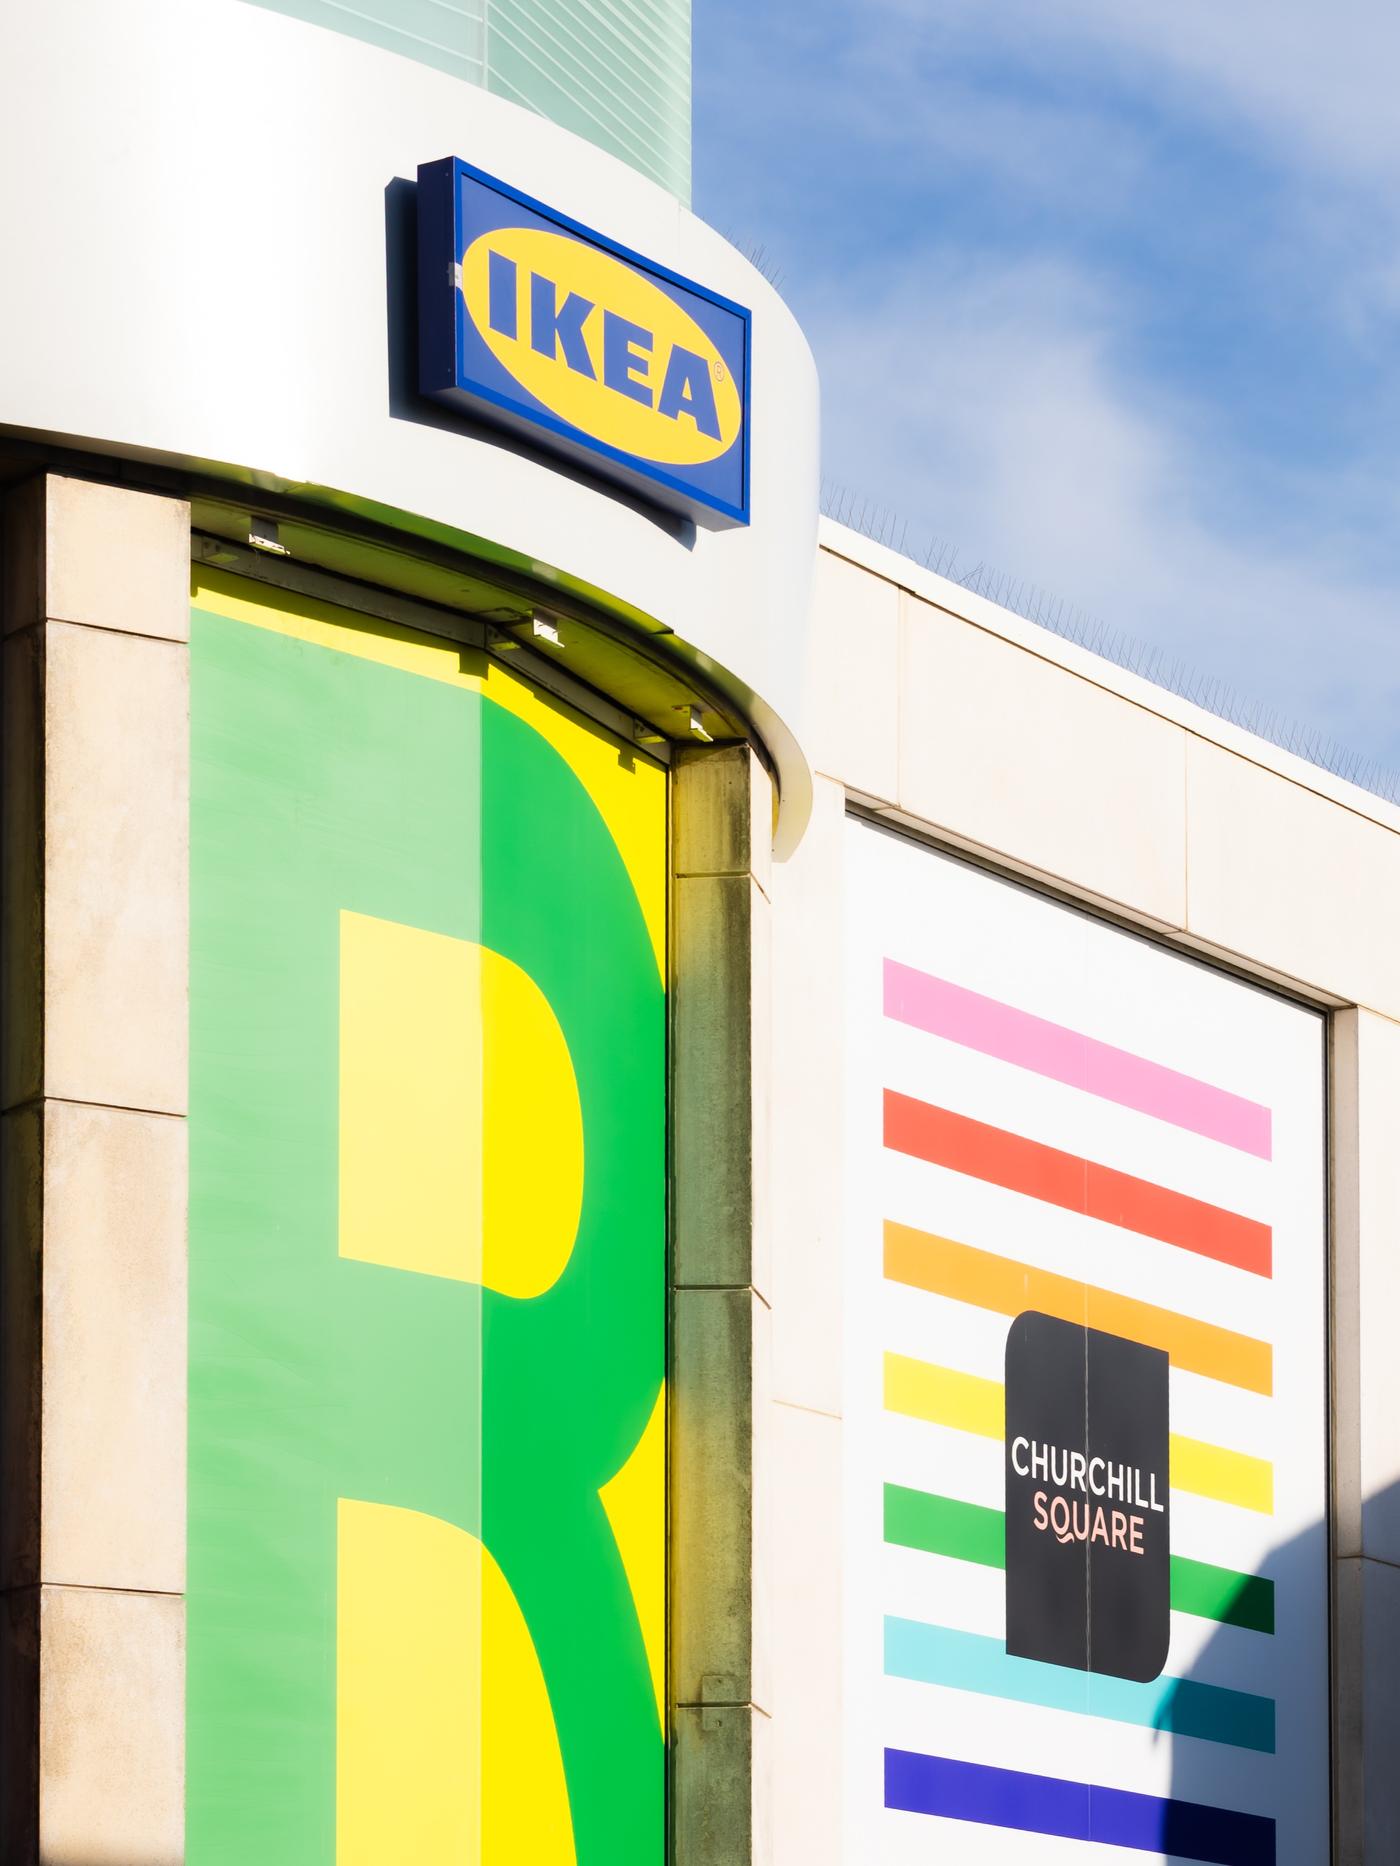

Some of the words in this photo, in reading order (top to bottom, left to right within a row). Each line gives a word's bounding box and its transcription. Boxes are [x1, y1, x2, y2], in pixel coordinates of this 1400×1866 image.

[488, 248, 723, 443] IKEA
[1011, 1436, 1164, 1512] CHURCHILL
[1033, 1491, 1144, 1554] SQUARE
